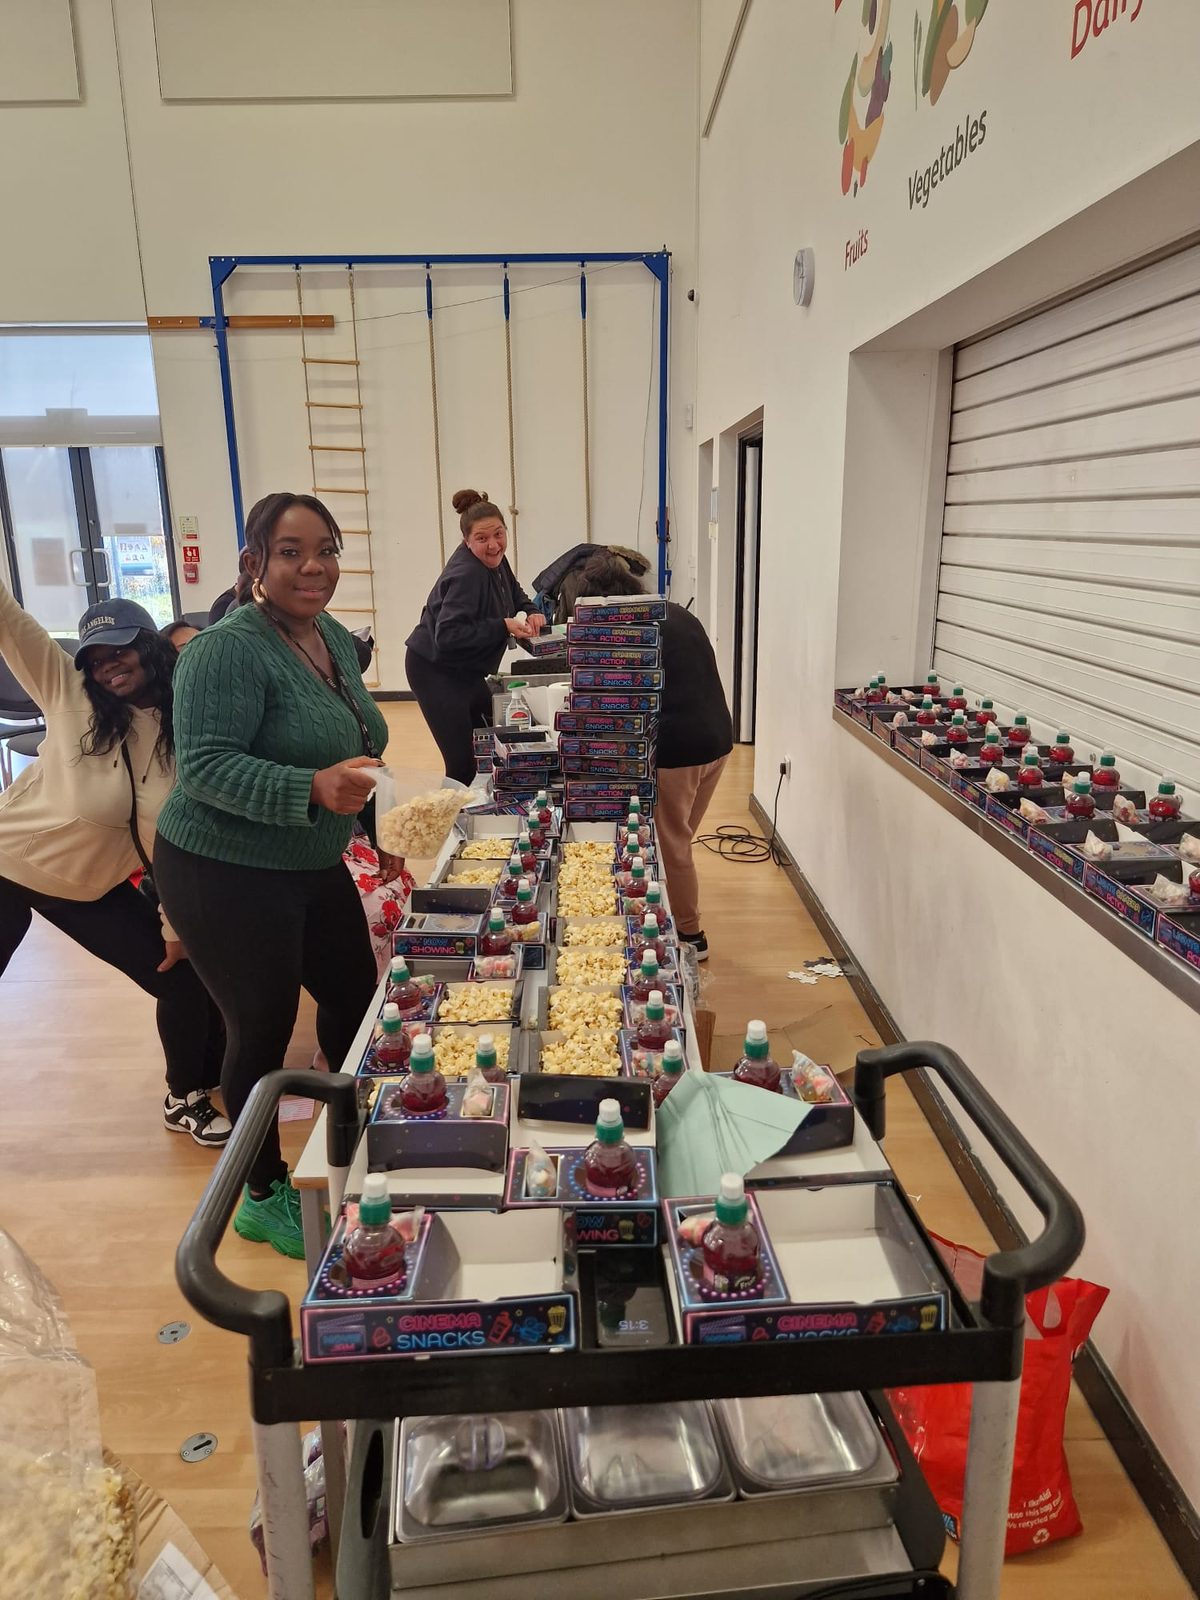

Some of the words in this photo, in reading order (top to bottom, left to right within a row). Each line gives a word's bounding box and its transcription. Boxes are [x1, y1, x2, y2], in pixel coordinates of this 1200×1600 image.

[908, 110, 987, 210] Vegetables
[844, 229, 868, 271] Fruits
[608, 613, 635, 621] ACTION
[1106, 892, 1127, 914] ACTION
[411, 946, 456, 954] SHOWING
[398, 1312, 482, 1332] CINEMA
[618, 1320, 649, 1330] 3:15
[777, 1312, 857, 1331] CINEMA
[397, 1330, 485, 1350] SNACKS
